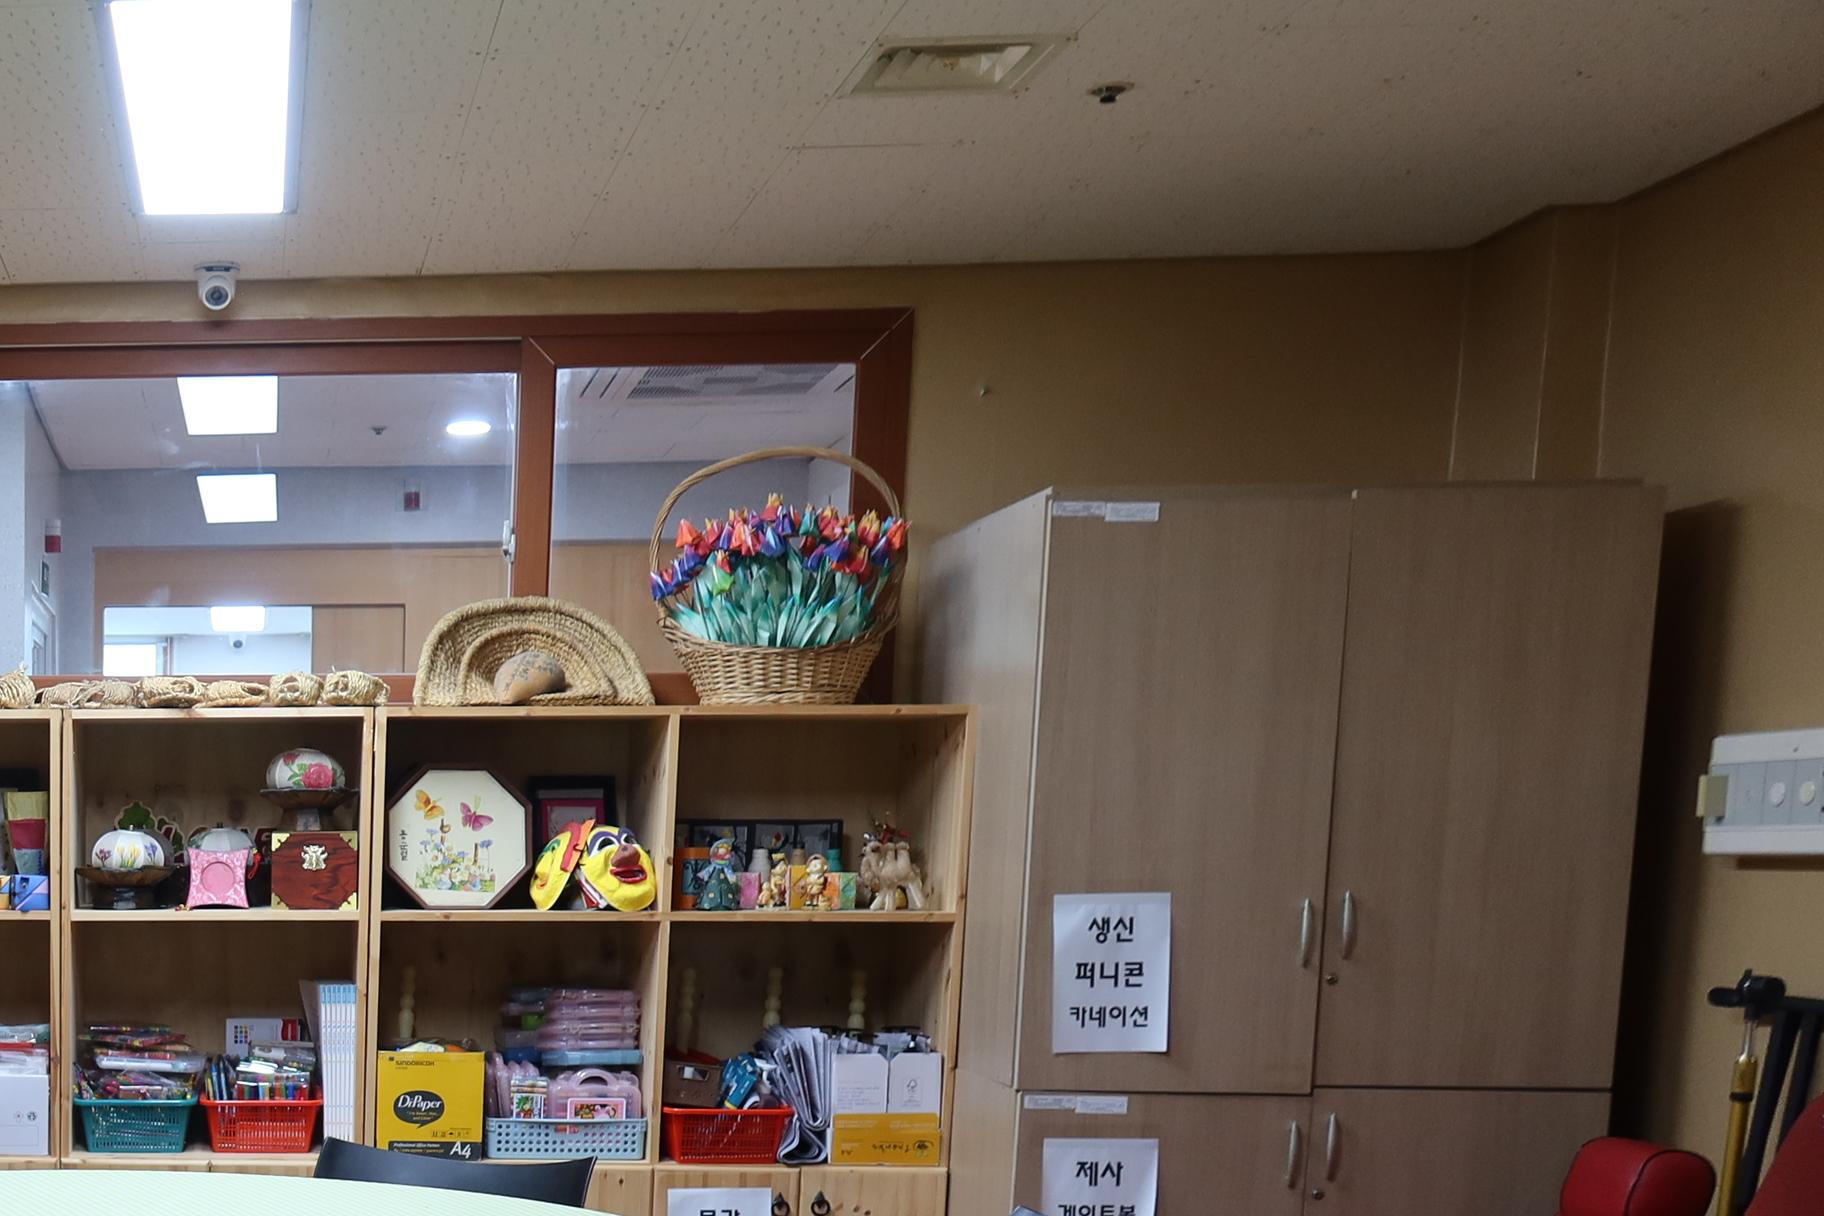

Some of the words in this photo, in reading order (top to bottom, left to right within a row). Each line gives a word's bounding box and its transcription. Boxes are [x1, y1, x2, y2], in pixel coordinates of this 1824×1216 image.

[1088, 916, 1134, 944] 생신
[1075, 961, 1144, 988] 퍼니콘
[1069, 1005, 1149, 1029] 카네이션
[449, 1141, 472, 1159] A4
[1075, 1161, 1124, 1187] 제사
